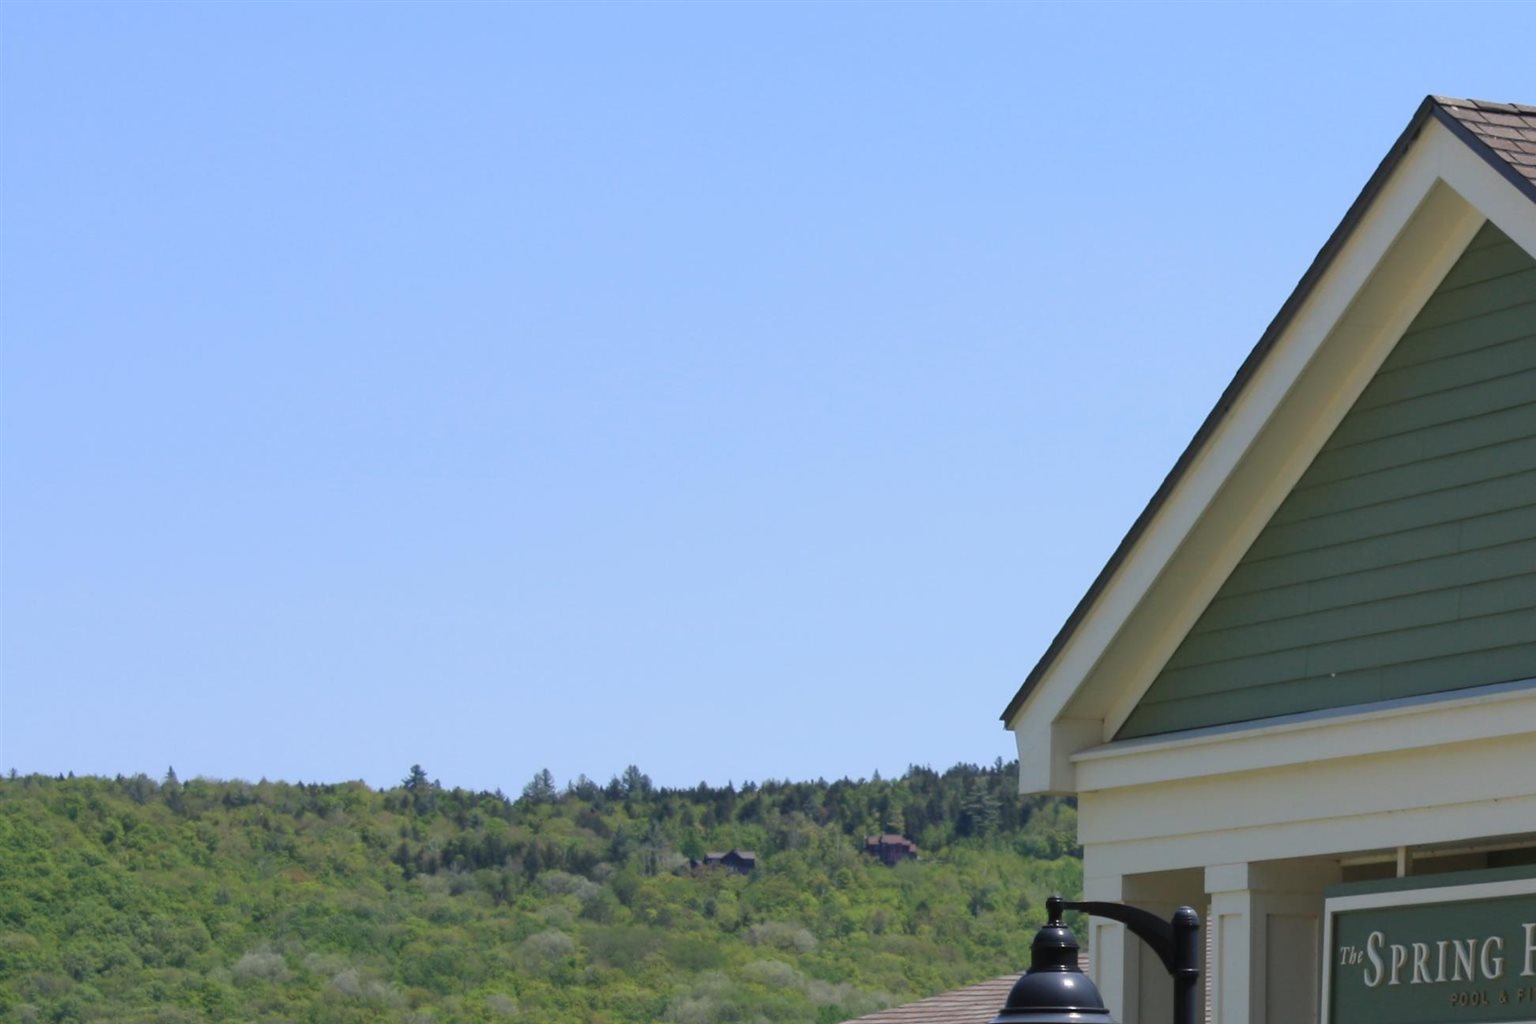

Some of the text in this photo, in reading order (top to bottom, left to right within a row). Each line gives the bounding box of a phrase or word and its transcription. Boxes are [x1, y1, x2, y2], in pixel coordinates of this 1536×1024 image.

[1340, 945, 1364, 967] The
[1363, 930, 1505, 987] SPRING
[1450, 992, 1489, 1007] POOL
[1498, 991, 1508, 1004] &
